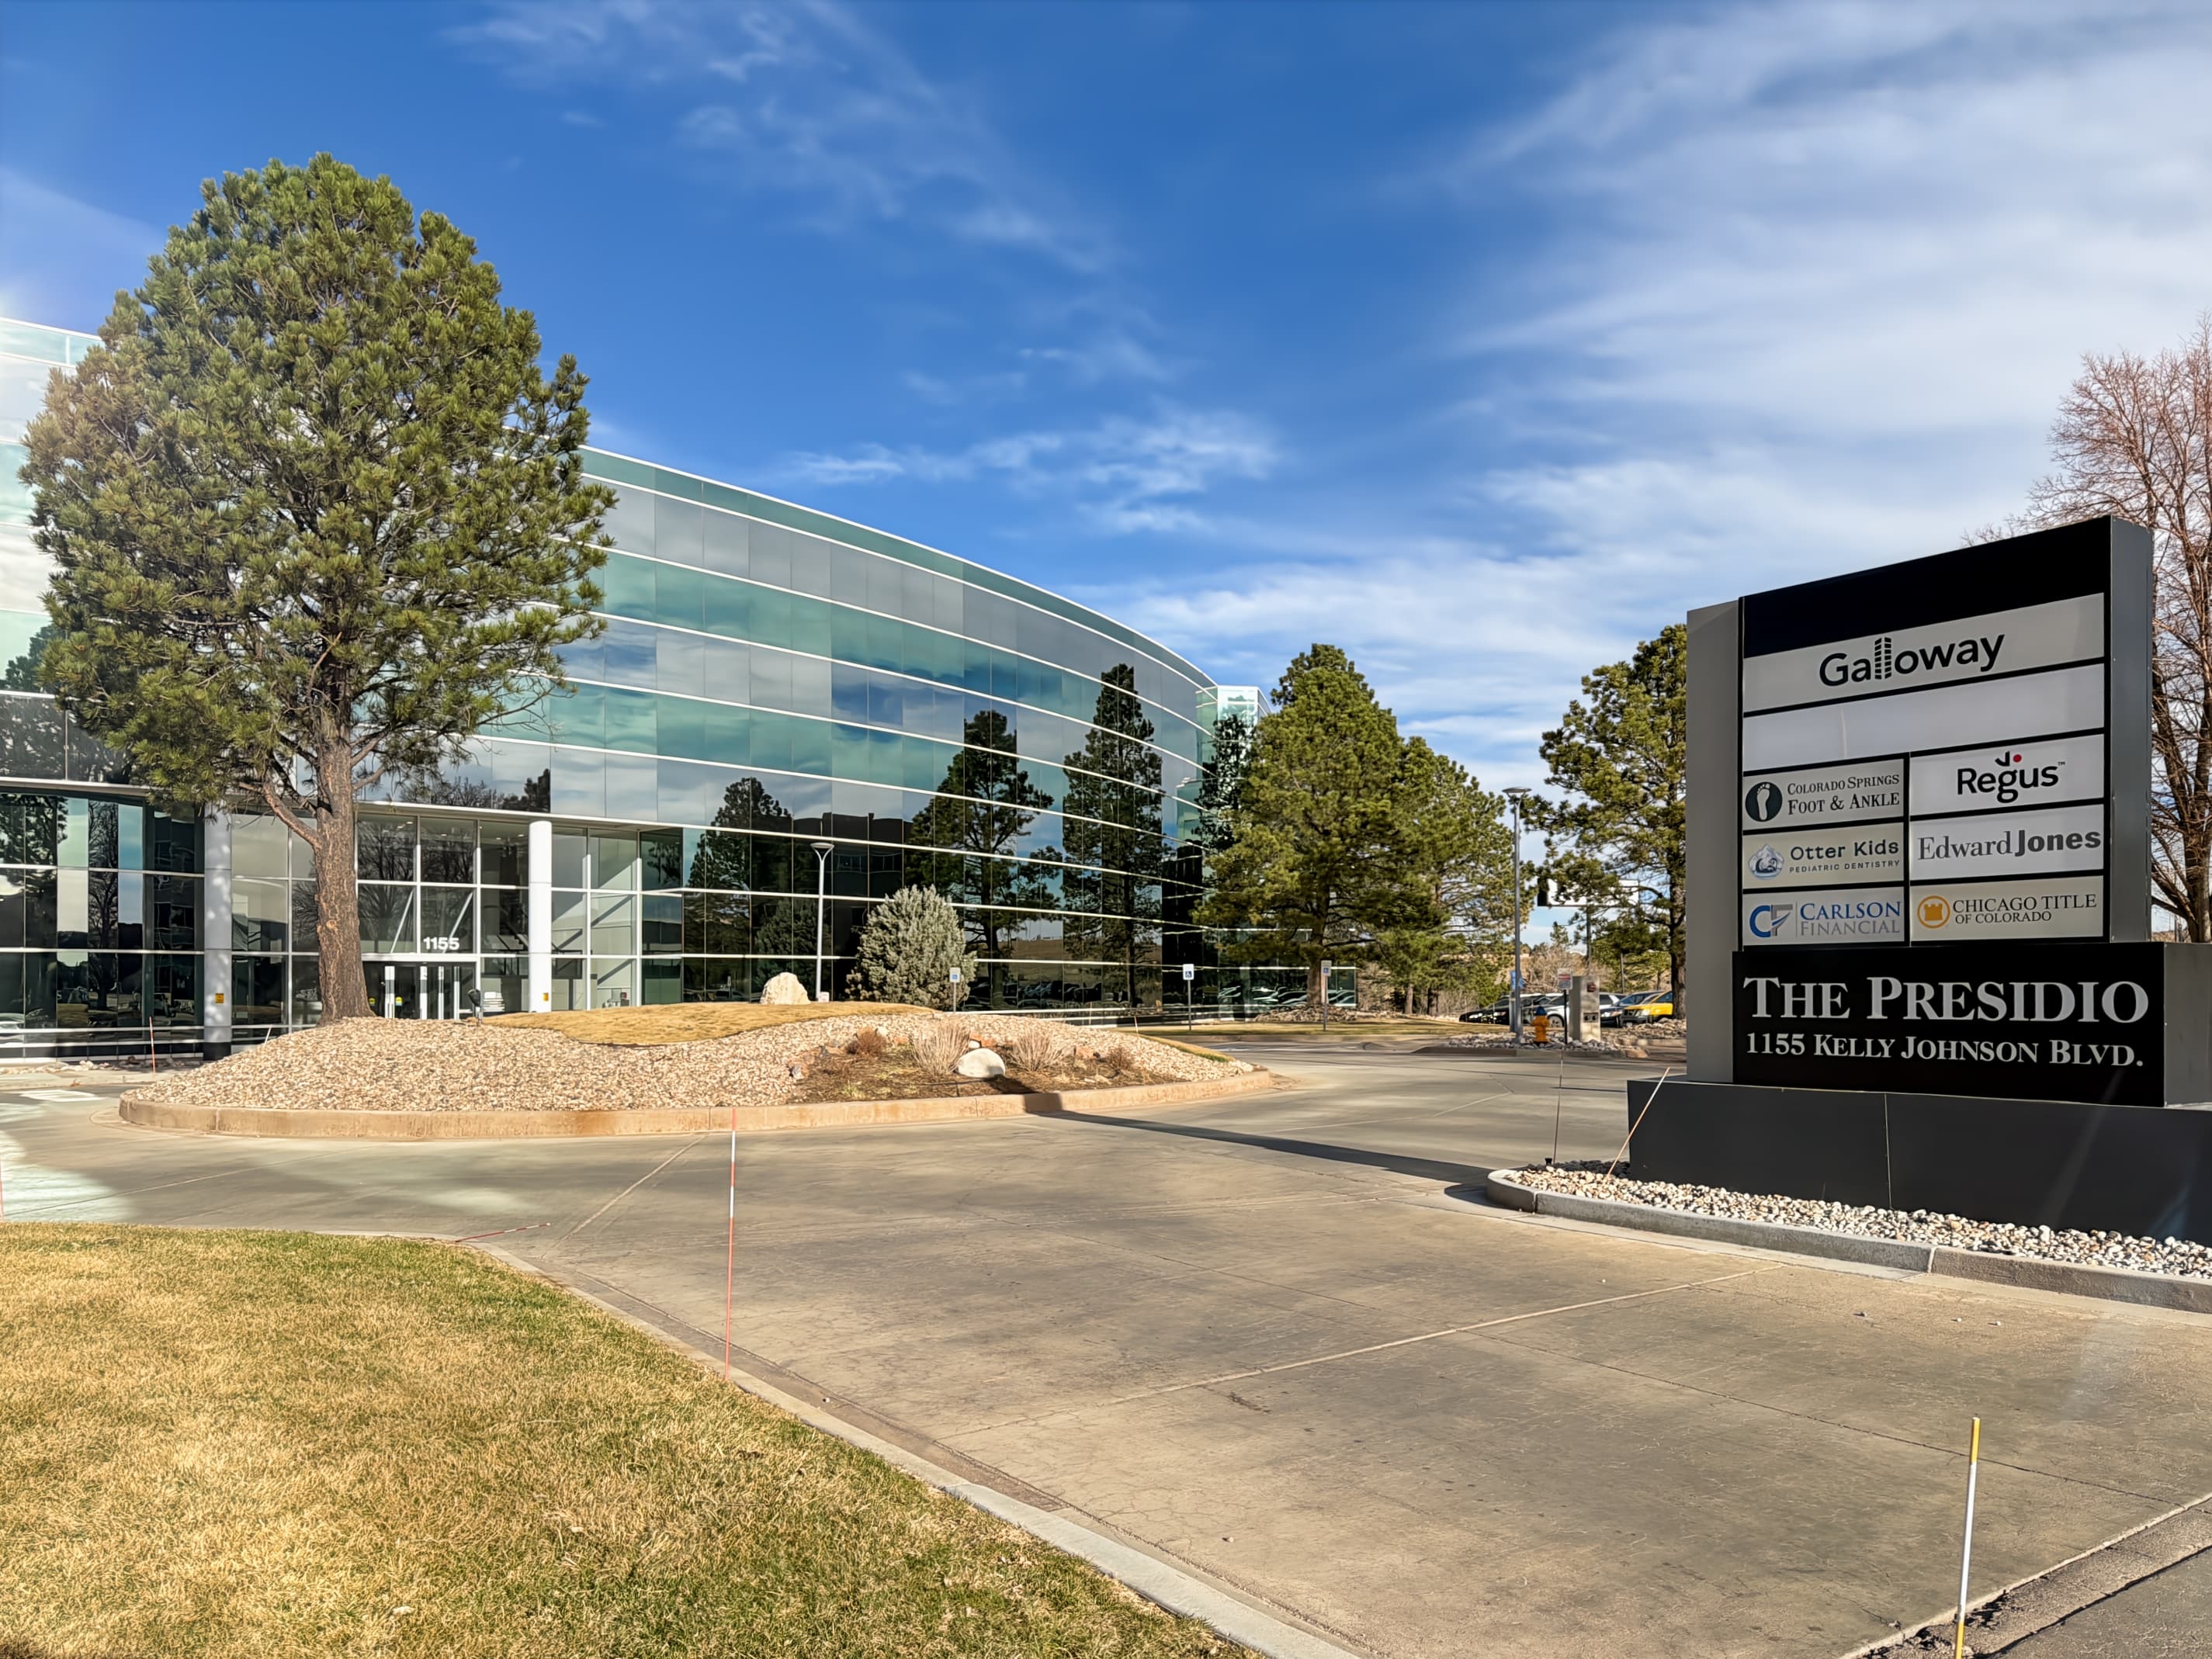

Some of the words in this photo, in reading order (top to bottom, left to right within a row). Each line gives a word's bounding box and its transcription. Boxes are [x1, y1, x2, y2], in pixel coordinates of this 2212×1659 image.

[1819, 634, 2005, 687] Galloway
[1787, 780, 1846, 795] COLORADO
[1847, 774, 1900, 789] SPRINGS
[1957, 765, 2059, 804] Regus
[1787, 799, 1825, 815] FOOT
[1830, 795, 1844, 810] &
[1850, 792, 1900, 809] ANKLE
[1790, 846, 1846, 861] Otter
[1853, 840, 1898, 857] Kids
[1917, 830, 2011, 861] Edward
[2014, 830, 2101, 857] Jones
[1789, 864, 1839, 874] PEDIATRIC
[1844, 860, 1900, 870] DENTISTRY
[1800, 901, 1901, 921] CARLSON
[1953, 896, 2037, 913] CHICAGO
[2041, 894, 2097, 909] TITLE
[1801, 920, 1900, 936] FINANCIAL
[1955, 914, 1972, 924] OF
[1975, 911, 2052, 924] COLORADO
[423, 937, 460, 951] 1155
[1743, 976, 1850, 1019] THE
[1866, 976, 2149, 1023] PRESIDIO
[1747, 1032, 1805, 1055] 1155
[1813, 1034, 1895, 1058] KELLY
[1901, 1036, 2039, 1063] JOHNSON
[2049, 1040, 2144, 1067] BLVD.
